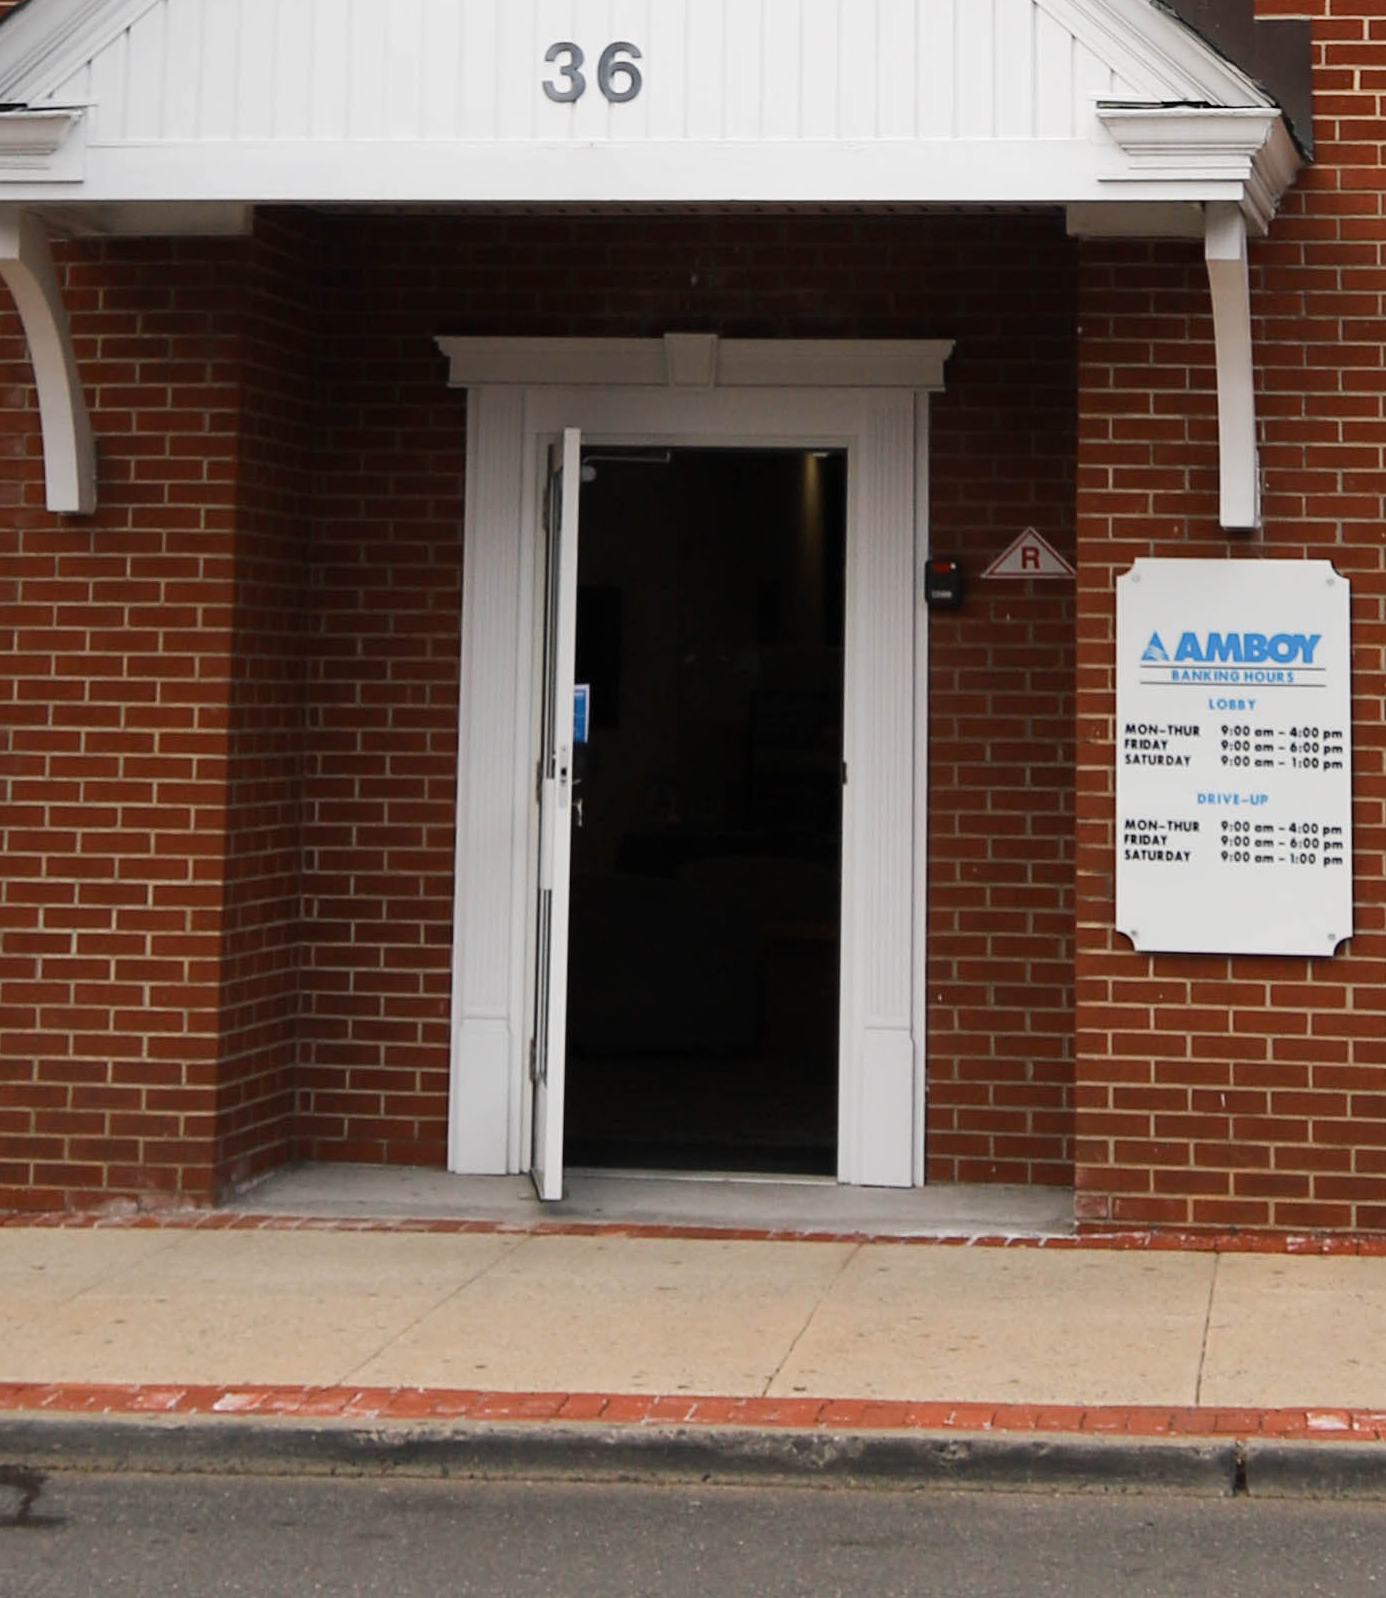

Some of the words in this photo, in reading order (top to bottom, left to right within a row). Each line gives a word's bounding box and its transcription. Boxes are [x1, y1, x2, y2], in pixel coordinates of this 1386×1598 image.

[542, 41, 642, 104] 36
[1021, 546, 1040, 570] R
[1173, 631, 1323, 664] AMBOY
[1171, 669, 1240, 683] BANKING
[1244, 670, 1294, 684] HOURS
[1208, 698, 1257, 711] LOBBY
[1124, 723, 1200, 737] MON-THUR
[1221, 725, 1251, 737] 9:00
[1254, 727, 1274, 739] am
[1289, 727, 1319, 739] 4:00
[1323, 729, 1343, 741] pm
[1124, 739, 1169, 751] FRIDAY
[1221, 739, 1251, 753] 9:00
[1254, 743, 1274, 753] am
[1289, 741, 1319, 755] 6:00
[1323, 745, 1343, 757] pm
[1124, 754, 1191, 767] SATURDAY
[1221, 755, 1251, 768] 9:00
[1254, 758, 1274, 769] am
[1292, 757, 1319, 770] 1:00
[1323, 760, 1343, 772] pm
[1196, 792, 1269, 806] DRIVE-UP
[1124, 819, 1200, 833] MON-THUR
[1221, 821, 1251, 833] 9:00
[1254, 823, 1274, 835] am
[1289, 823, 1319, 835] 4:00
[1323, 825, 1343, 837] pm
[1124, 834, 1168, 847] FRIDAY
[1221, 835, 1251, 848] 9:00
[1254, 838, 1274, 849] am
[1289, 837, 1320, 850] 6:00
[1323, 840, 1343, 852] pm
[1124, 849, 1191, 863] SATURDAY
[1221, 851, 1251, 863] 9:00
[1254, 853, 1274, 865] am
[1290, 853, 1317, 865] 1:00
[1323, 855, 1343, 867] pm
